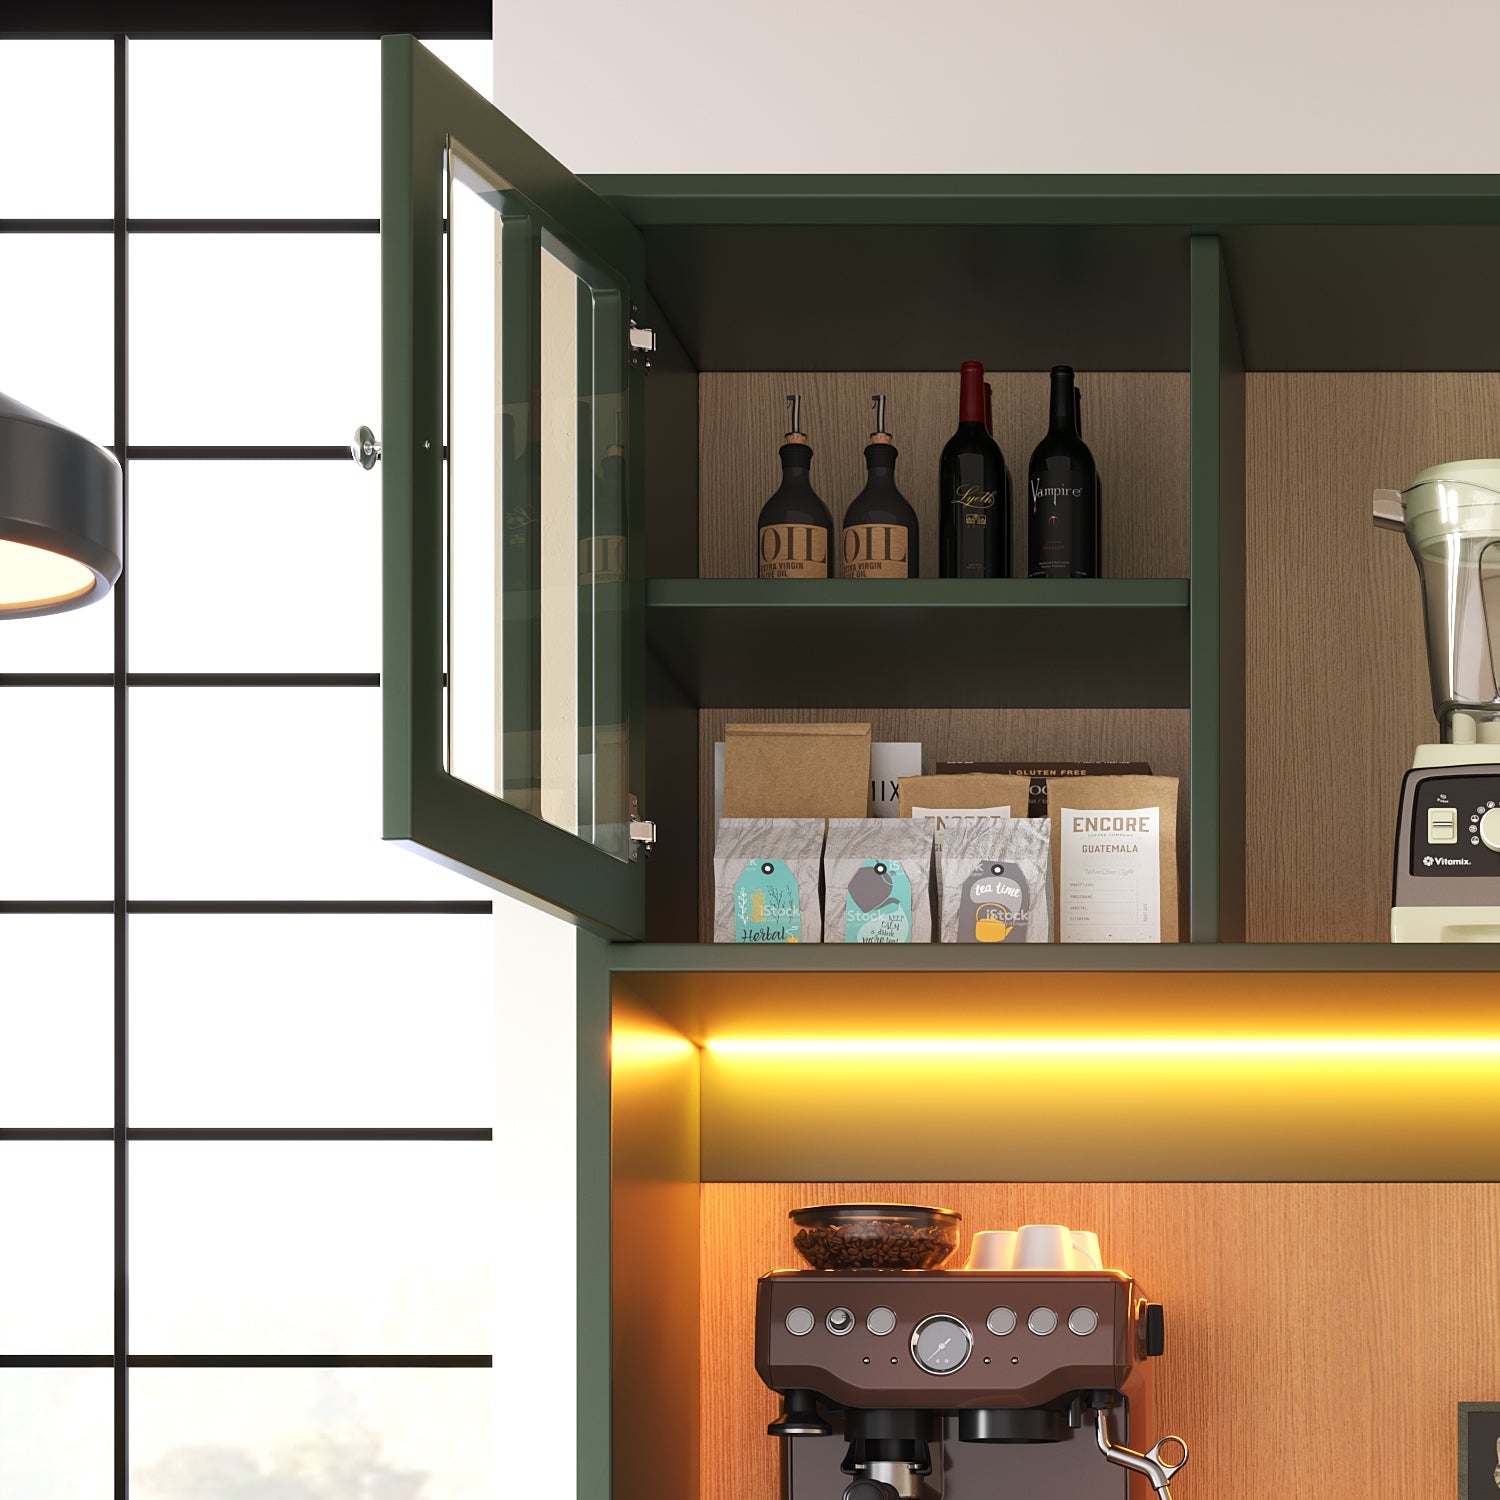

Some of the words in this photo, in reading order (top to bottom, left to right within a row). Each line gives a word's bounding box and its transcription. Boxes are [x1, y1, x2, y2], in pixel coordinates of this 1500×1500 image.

[1031, 478, 1080, 507] Vampire
[761, 526, 827, 564] OIL
[844, 526, 907, 564] OIL
[777, 569, 788, 577] OIL
[778, 562, 804, 570] VIRGIN
[858, 562, 882, 570] VIRGIN
[1073, 817, 1150, 832] ENCORE
[1082, 845, 1138, 853] GUATEMALA
[1434, 857, 1469, 865] Vitamix
[975, 883, 993, 896] tea
[996, 882, 1021, 898] time
[986, 908, 1028, 921] iStock
[741, 926, 785, 942] Herbal
